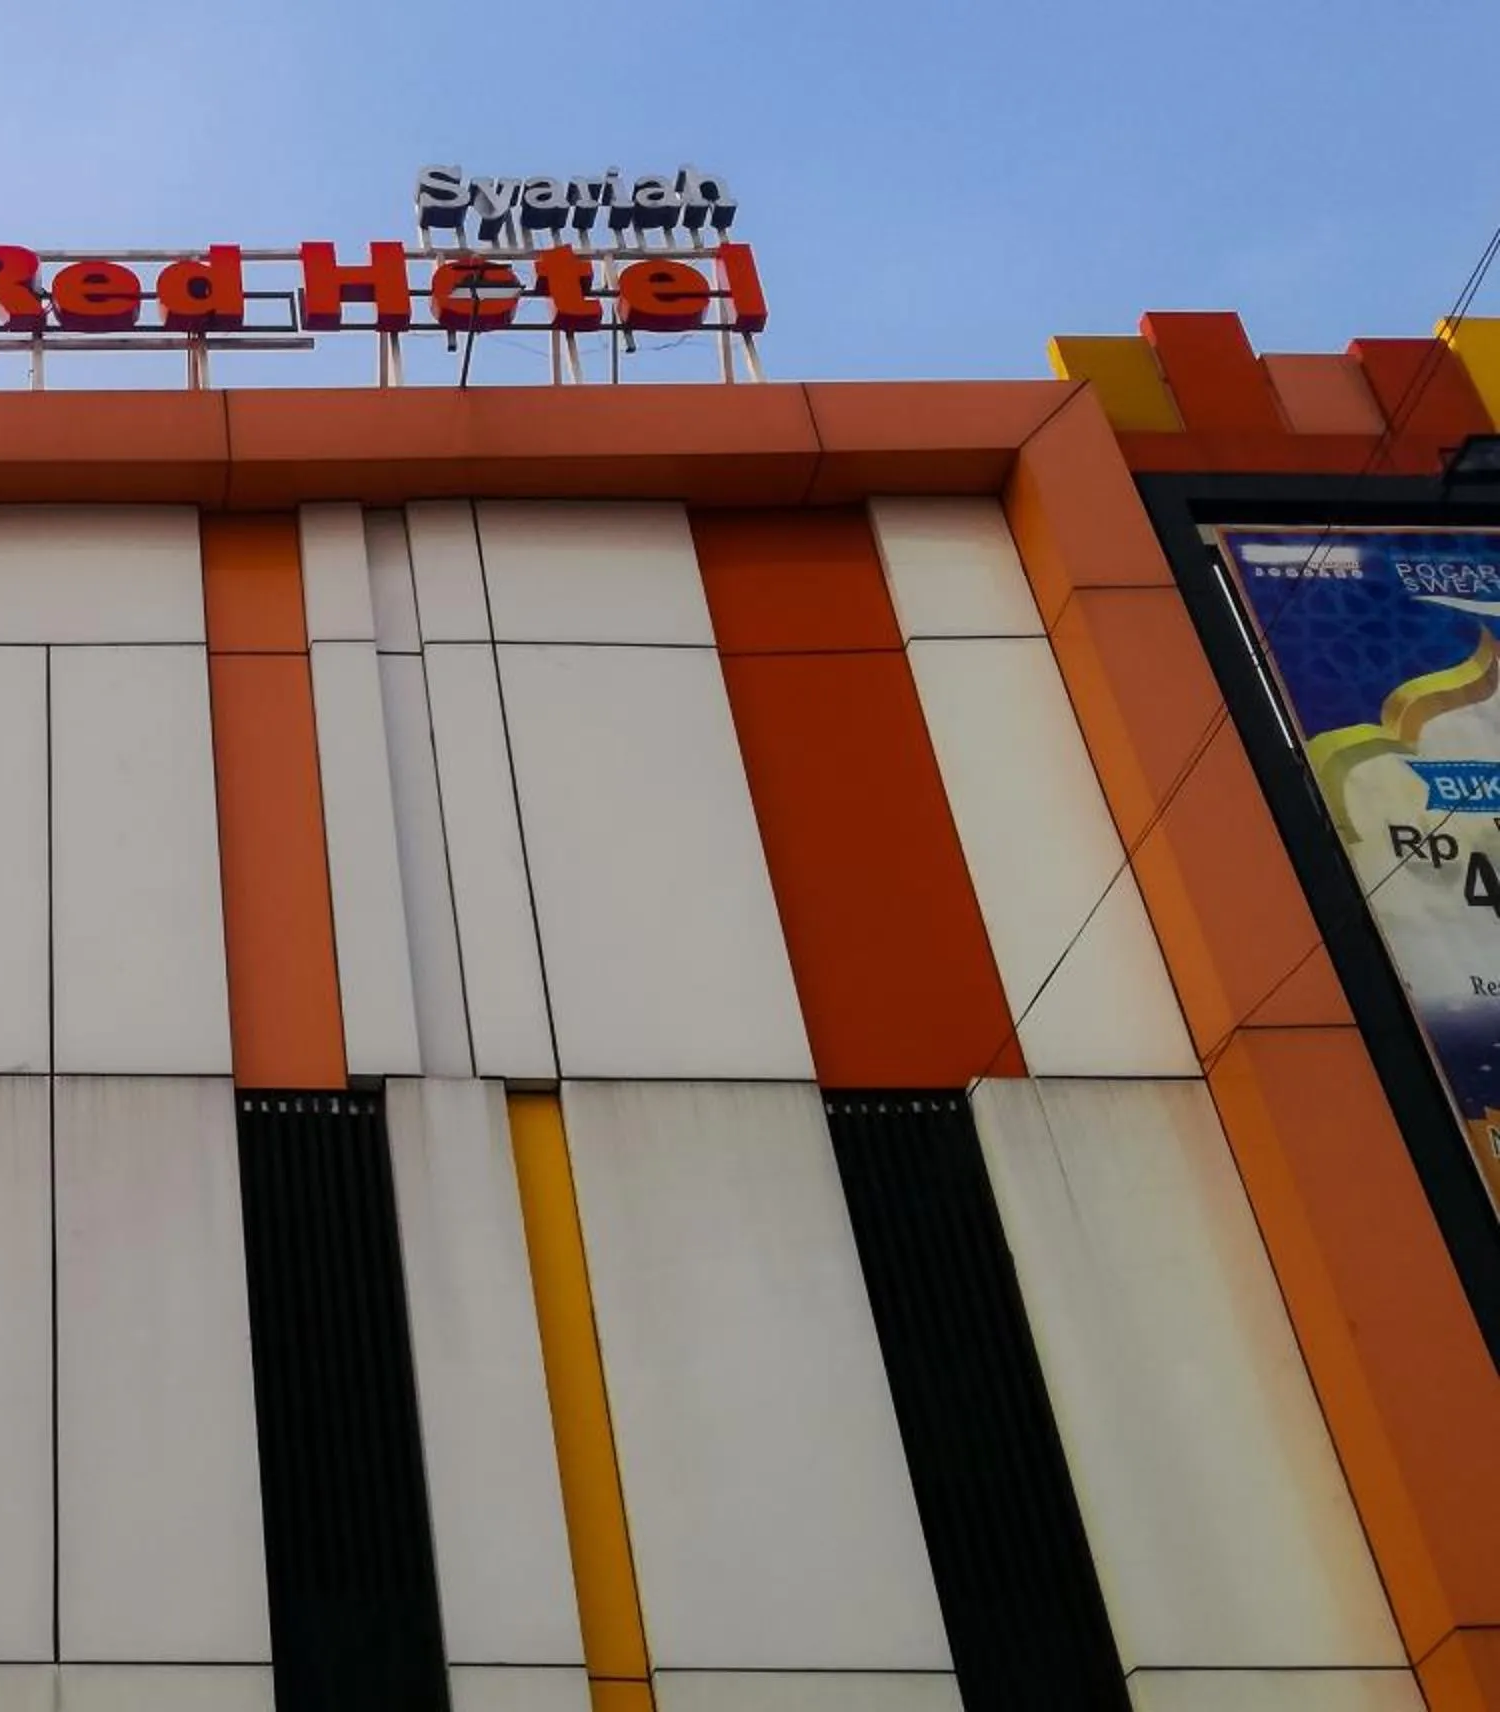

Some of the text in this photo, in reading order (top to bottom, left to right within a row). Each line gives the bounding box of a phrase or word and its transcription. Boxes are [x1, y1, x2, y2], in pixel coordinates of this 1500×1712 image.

[417, 164, 738, 230] Syariah
[300, 240, 767, 331] Hotel
[1388, 824, 1460, 870] Rp
